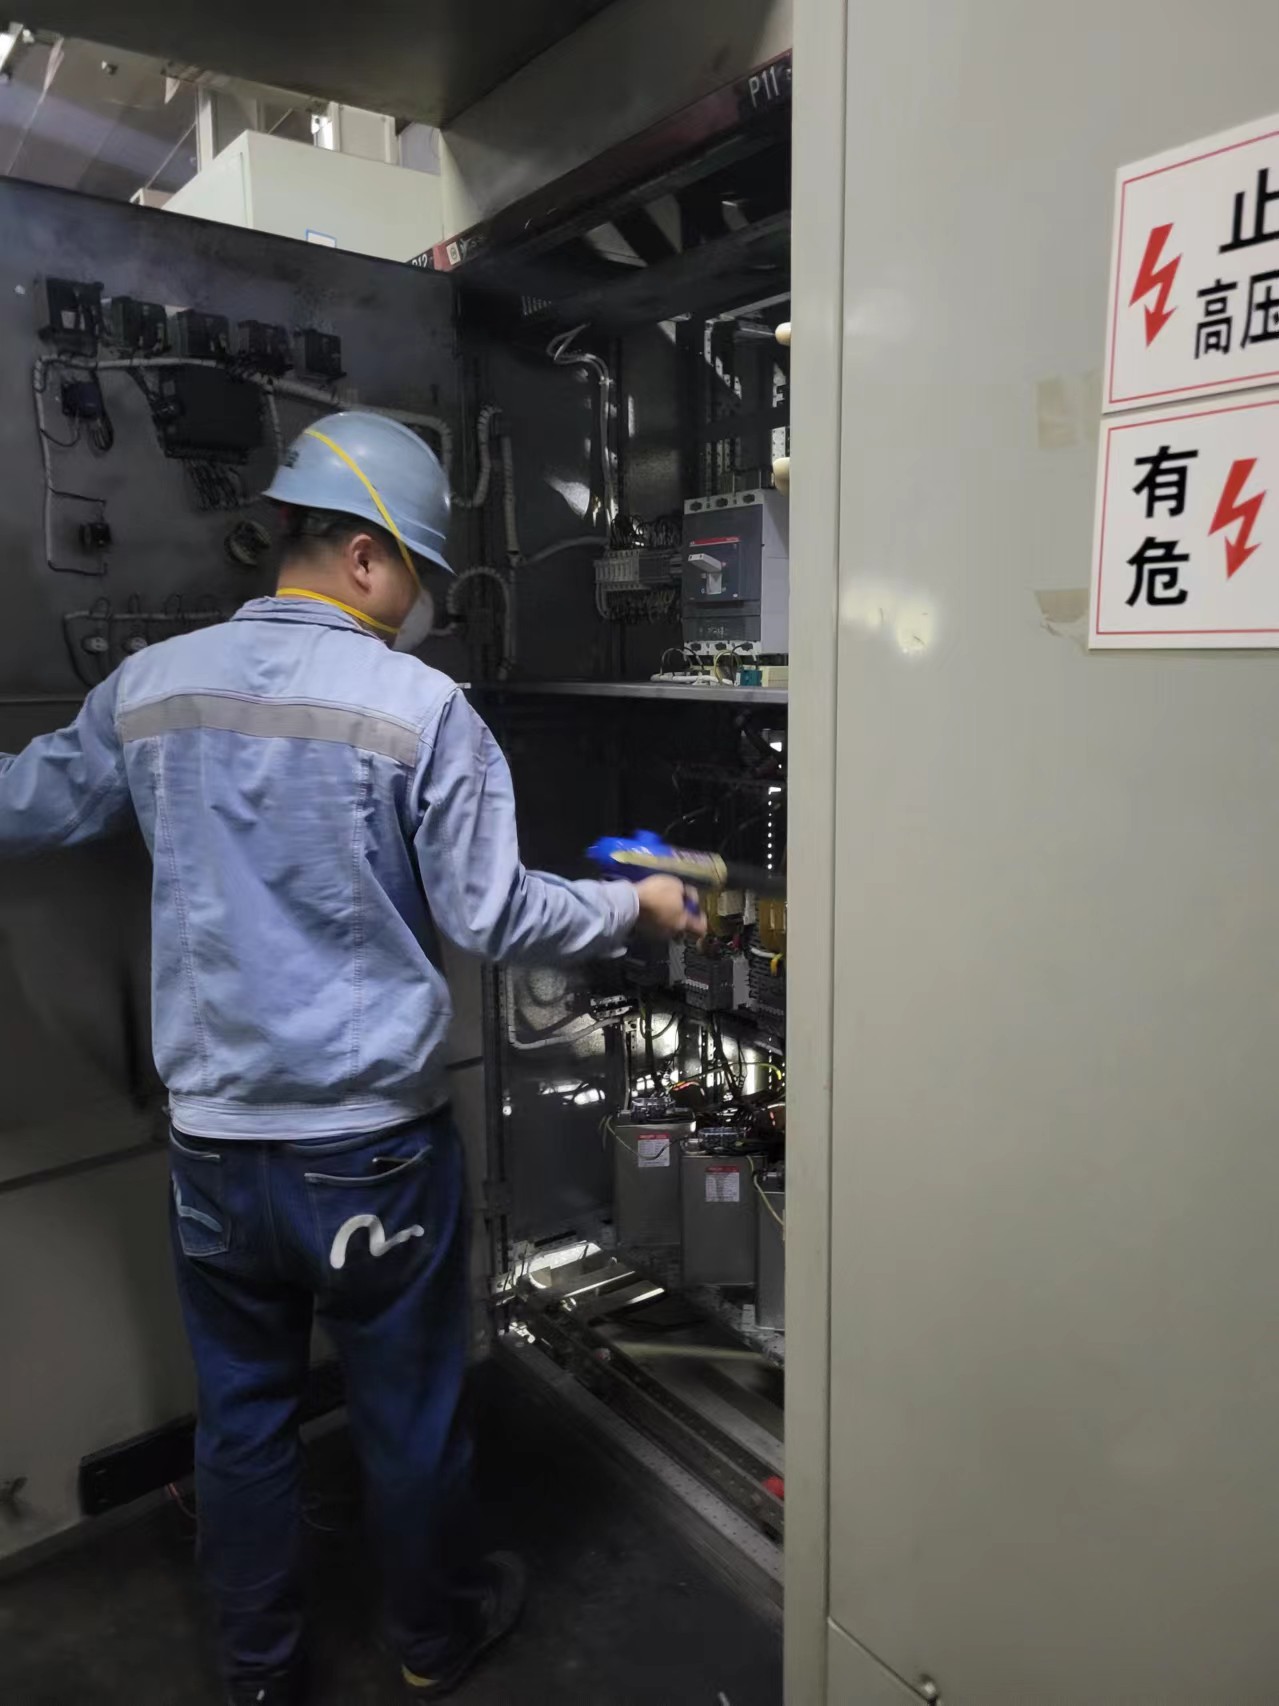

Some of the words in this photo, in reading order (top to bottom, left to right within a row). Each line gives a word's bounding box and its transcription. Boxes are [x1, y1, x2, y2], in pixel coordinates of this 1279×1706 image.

[1218, 168, 1279, 254] 止
[1194, 269, 1279, 360] 高压
[1132, 445, 1199, 518] 有
[1124, 536, 1190, 607] 危
